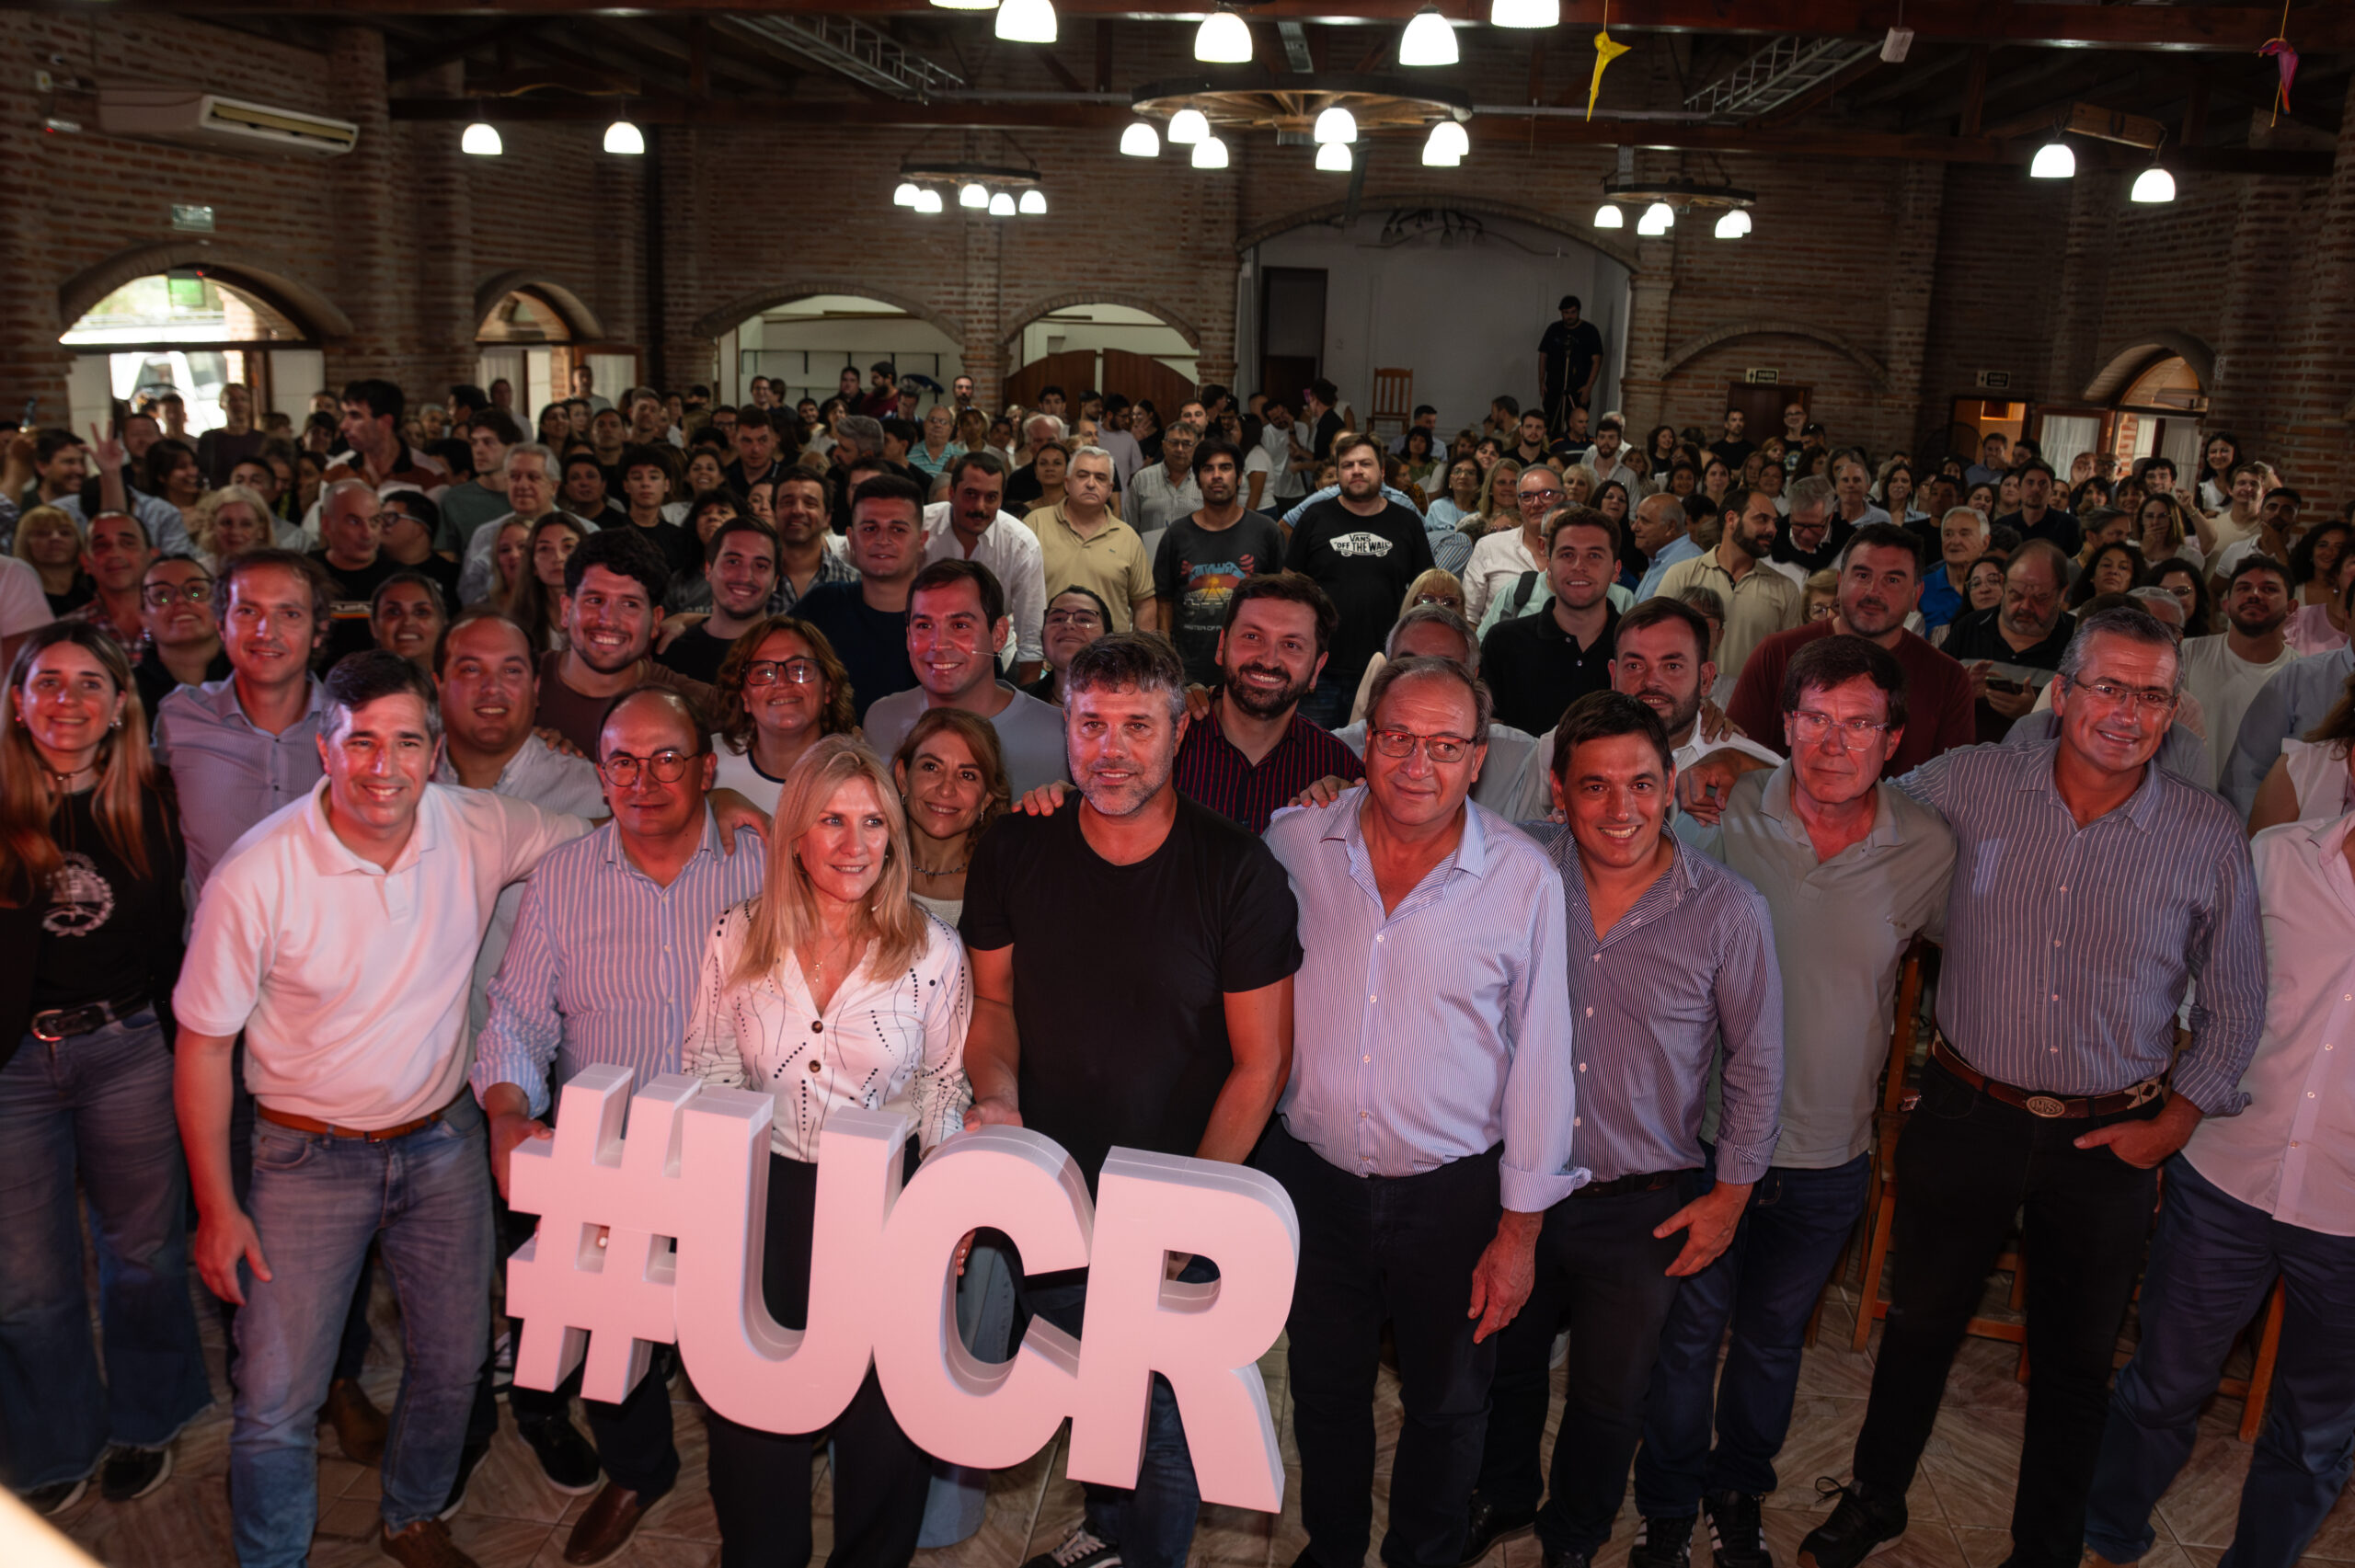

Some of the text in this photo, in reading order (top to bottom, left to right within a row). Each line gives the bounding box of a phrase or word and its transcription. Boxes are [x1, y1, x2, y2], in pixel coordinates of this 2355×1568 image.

[1350, 534, 1372, 543] VANS
[1352, 542, 1367, 553] THE
[507, 1064, 1299, 1513] #UCR
